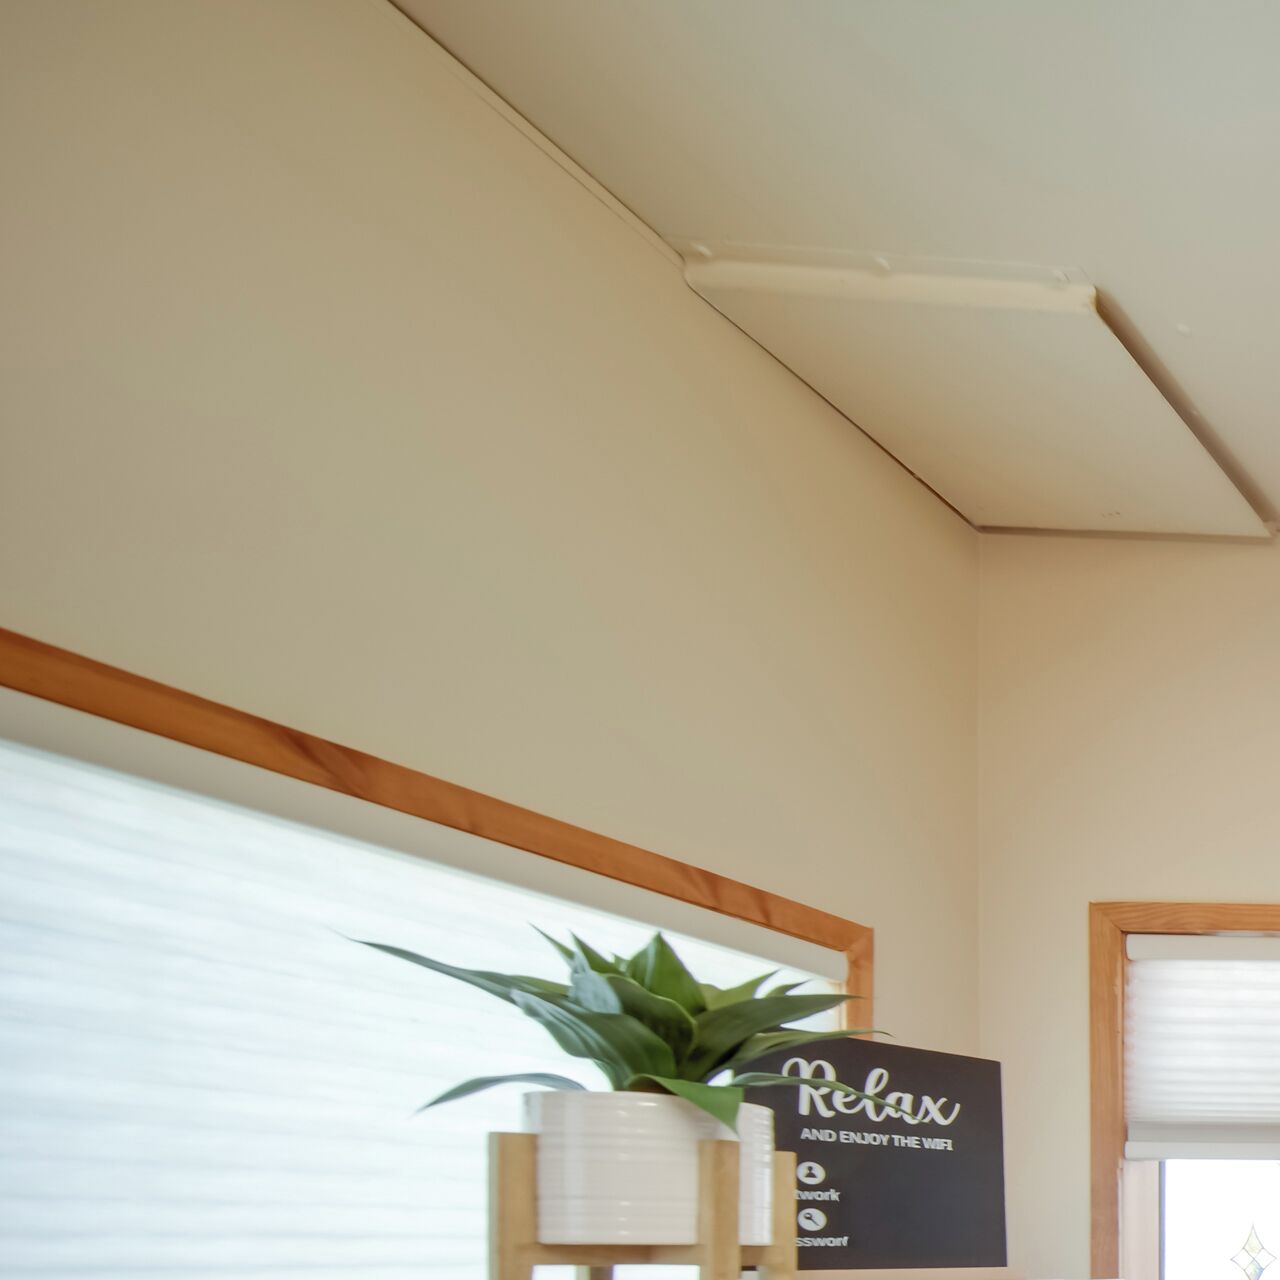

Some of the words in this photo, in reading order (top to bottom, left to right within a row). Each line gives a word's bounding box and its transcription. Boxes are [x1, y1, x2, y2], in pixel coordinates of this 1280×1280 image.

[782, 1057, 961, 1126] Relax
[801, 1128, 837, 1142] AND
[839, 1131, 891, 1146] ENJOY
[891, 1134, 921, 1149] THE
[794, 1188, 841, 1202] twork
